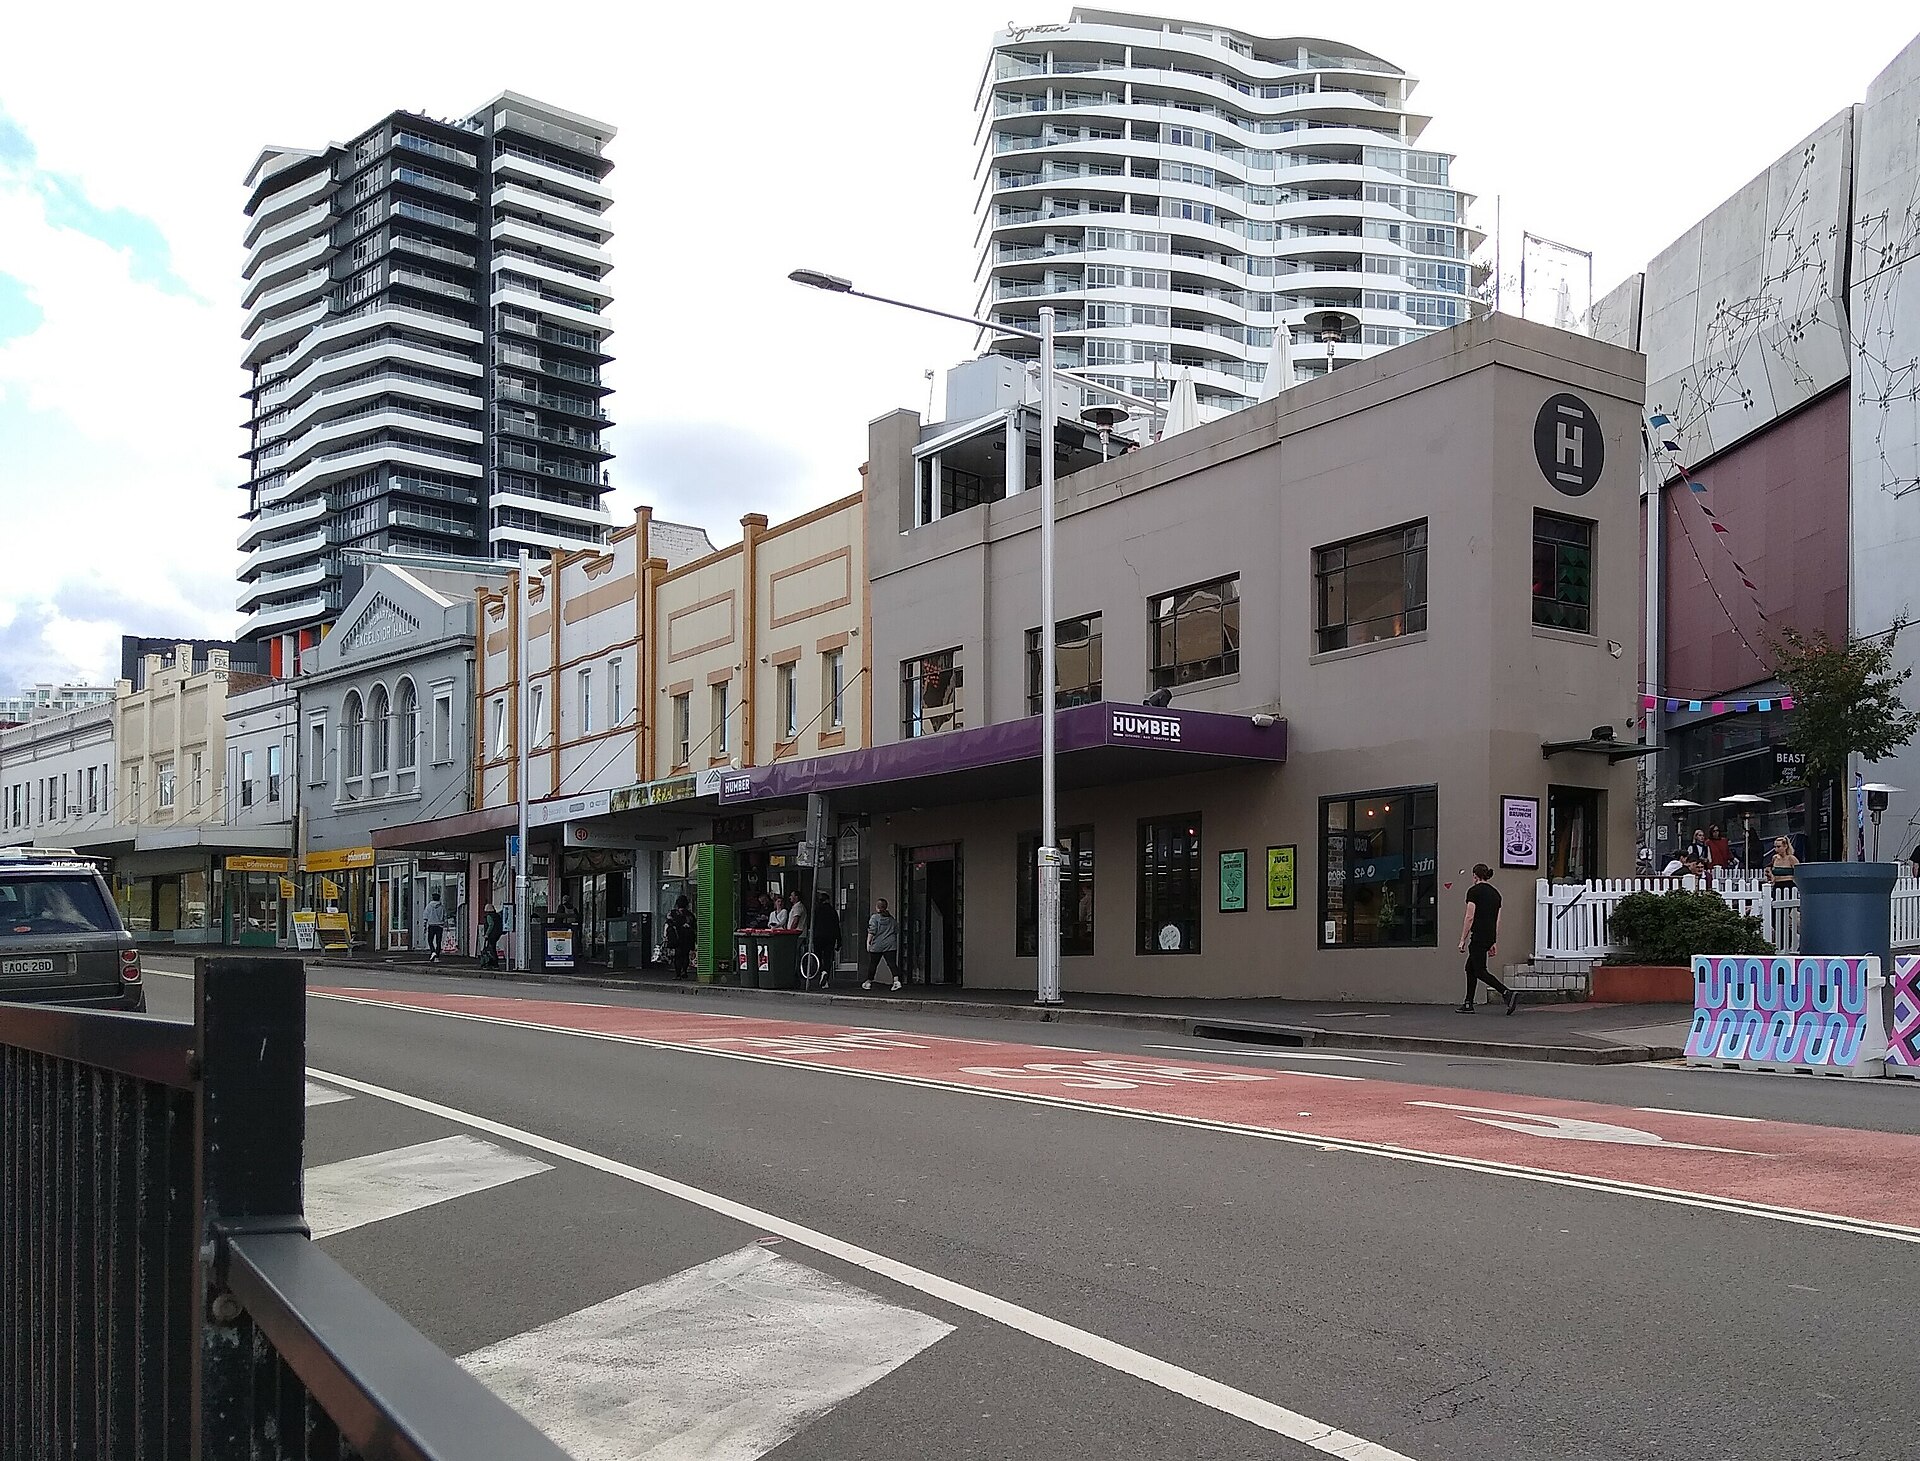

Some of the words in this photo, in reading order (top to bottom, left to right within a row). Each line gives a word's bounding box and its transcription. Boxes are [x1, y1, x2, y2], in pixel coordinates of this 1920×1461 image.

[1006, 21, 1070, 42] Signature
[1557, 421, 1583, 468] H
[393, 621, 413, 637] HALL
[1113, 716, 1181, 737] HUMBER
[1776, 752, 1806, 764] BEAST
[724, 778, 750, 794] HUMBER
[1508, 811, 1532, 819] BRUNCH
[1273, 855, 1289, 864] JUGS
[959, 1059, 1278, 1090] BUS
